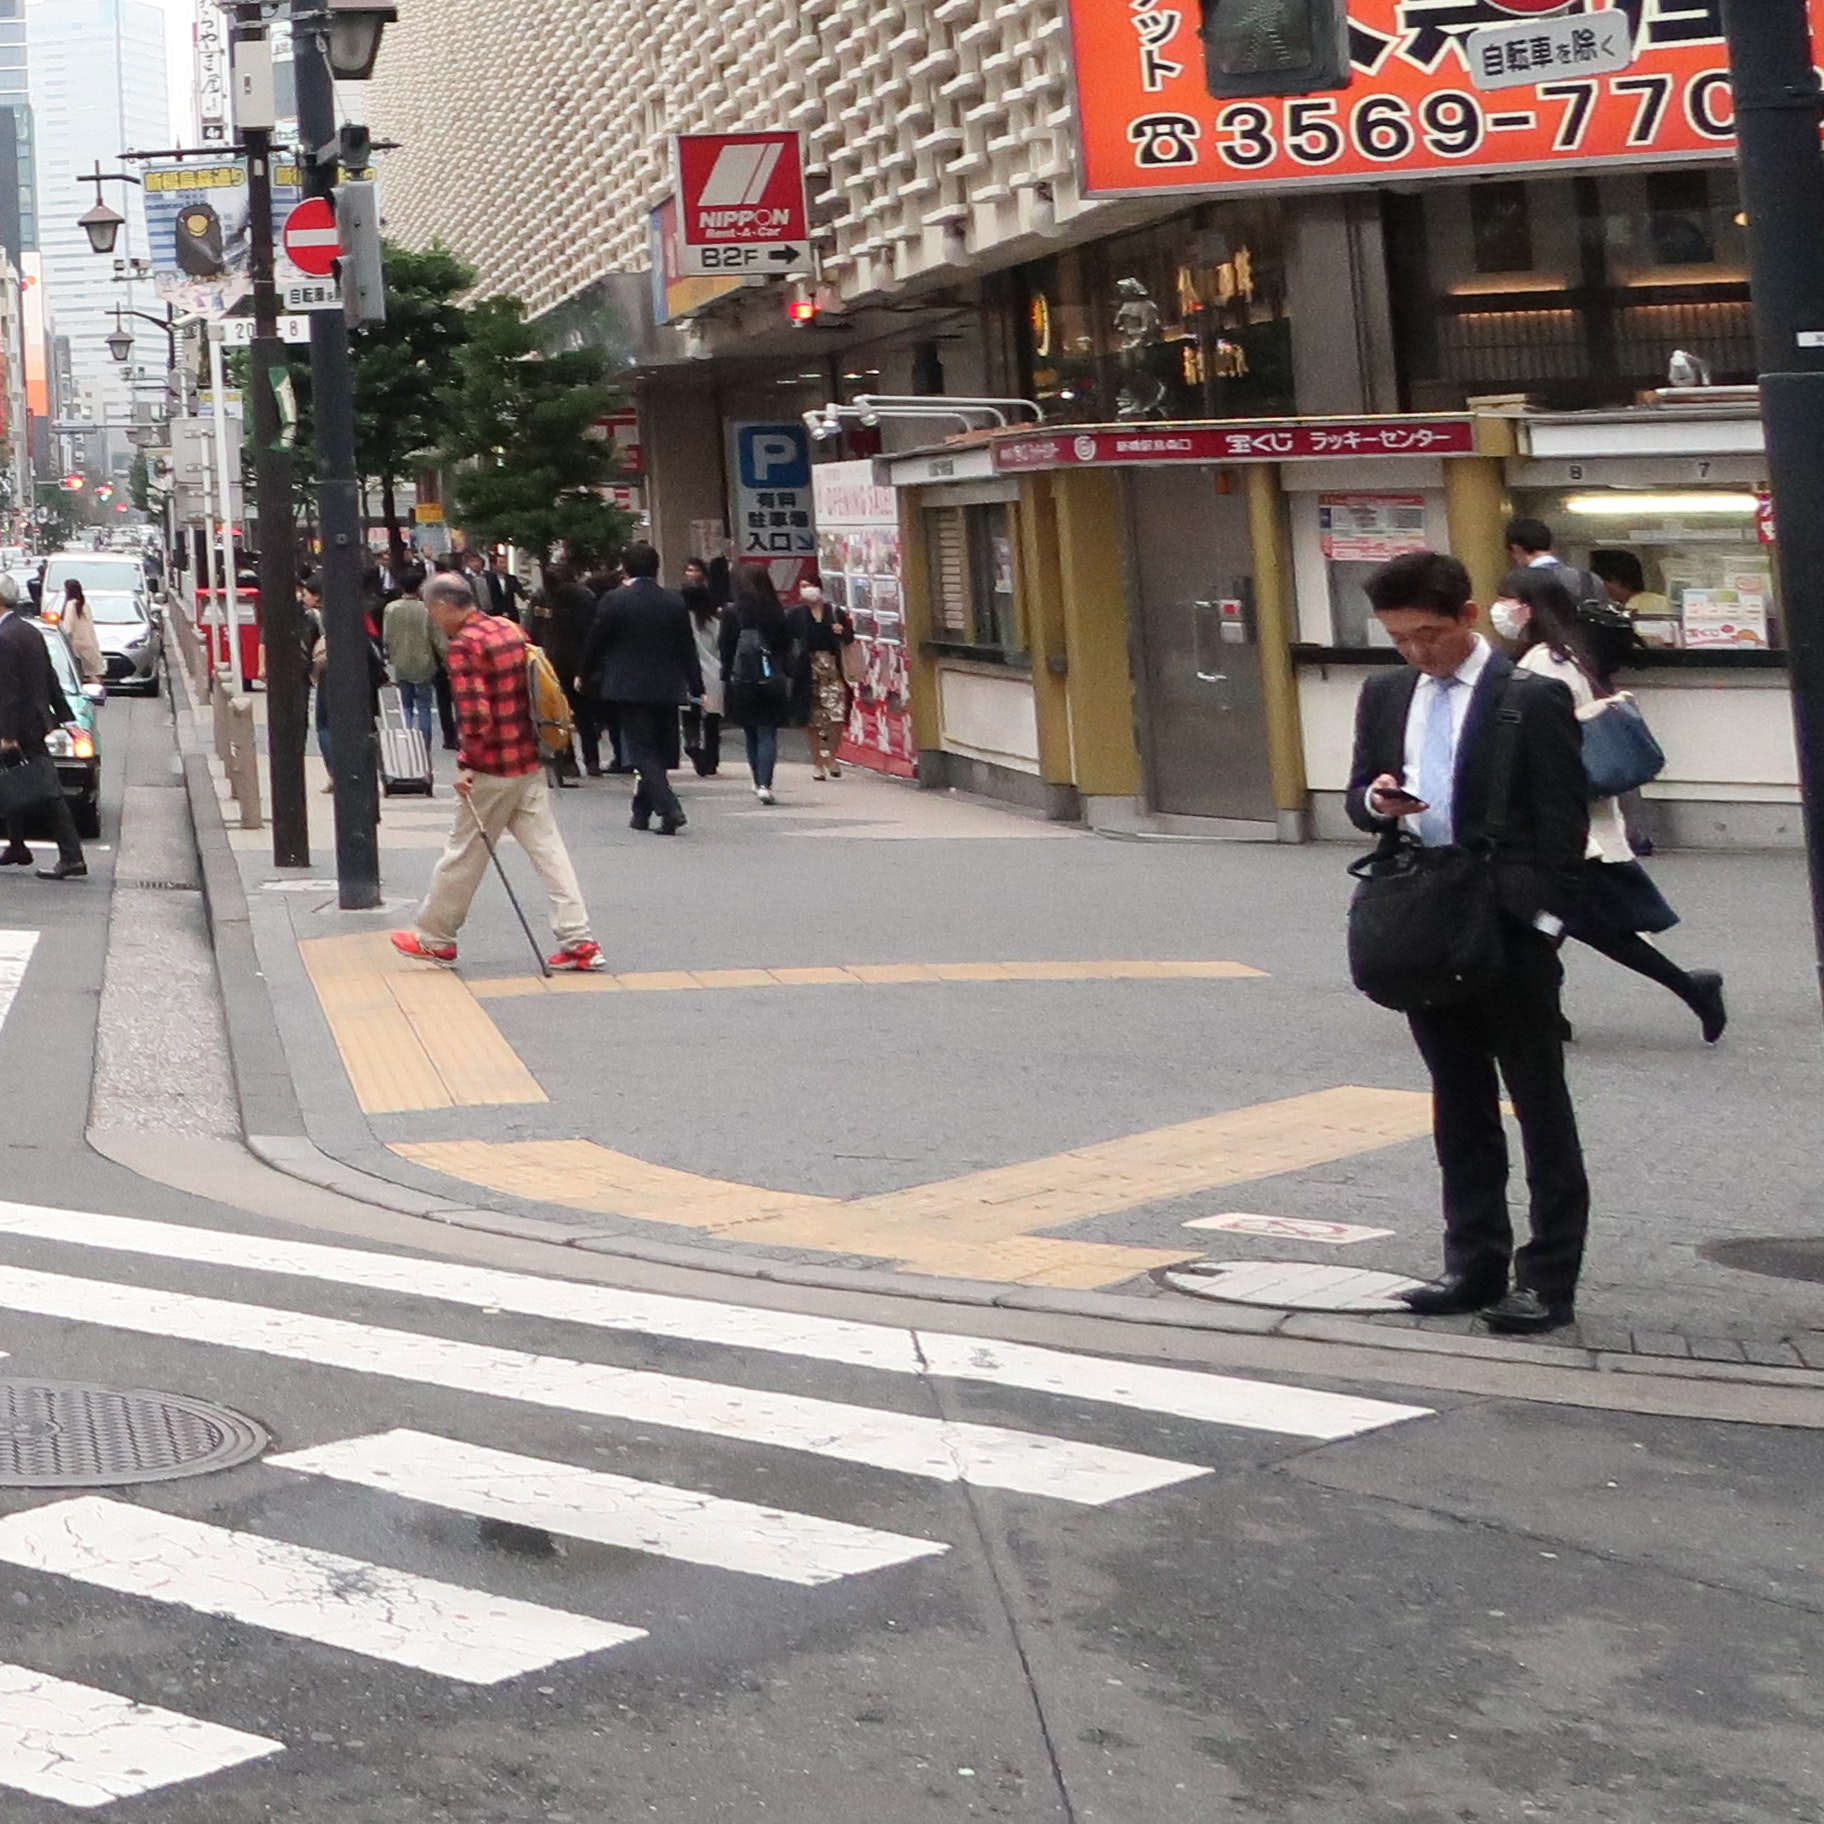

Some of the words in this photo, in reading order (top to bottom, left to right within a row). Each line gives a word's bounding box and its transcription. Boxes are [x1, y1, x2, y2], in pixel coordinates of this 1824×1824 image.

[1481, 27, 1618, 76] 自転車を除く
[699, 208, 790, 228] NIPPON
[702, 247, 759, 268] B2F
[1225, 432, 1294, 455] 宝くじ
[1309, 431, 1452, 452] ラッキーセンター
[752, 434, 798, 481] P
[756, 492, 797, 508] 有料
[747, 511, 809, 528] 駐車場
[745, 532, 792, 552] 入口
